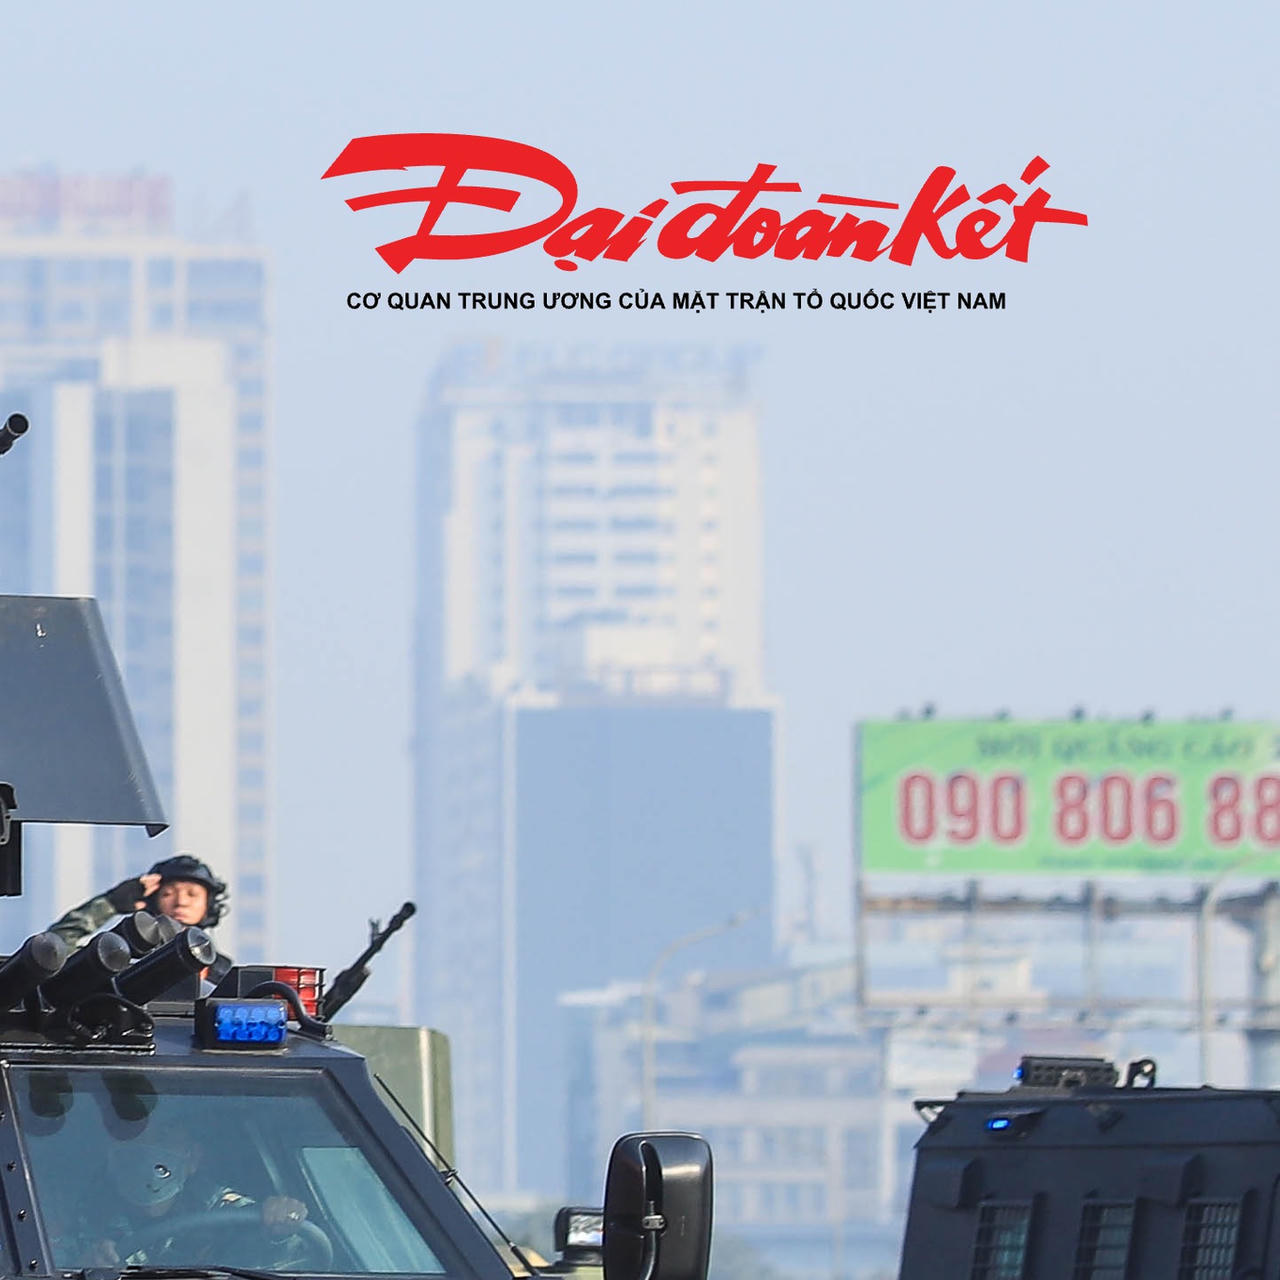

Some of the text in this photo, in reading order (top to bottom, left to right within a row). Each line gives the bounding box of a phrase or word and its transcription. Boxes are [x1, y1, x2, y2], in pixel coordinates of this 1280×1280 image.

[900, 773, 1280, 844] 090 806 88
